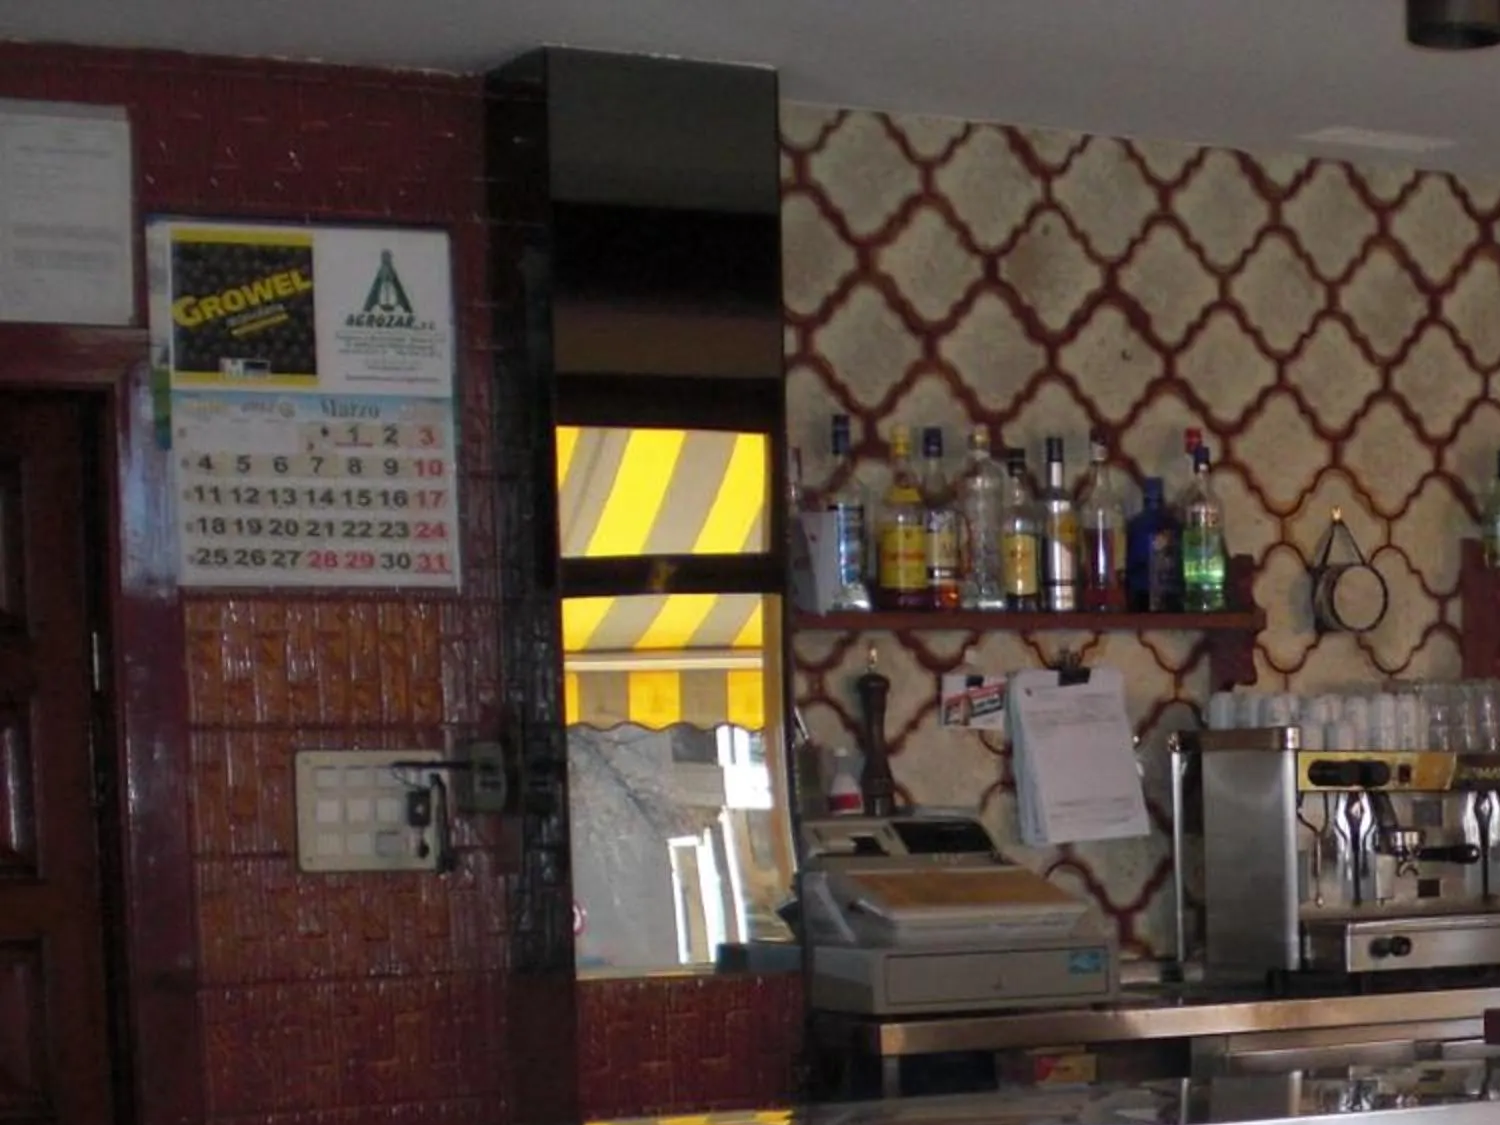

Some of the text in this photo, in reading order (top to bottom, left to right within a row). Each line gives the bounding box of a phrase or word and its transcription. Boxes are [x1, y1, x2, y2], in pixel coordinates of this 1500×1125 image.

[172, 269, 312, 327] GROWEL
[320, 398, 381, 419] Marzo
[348, 426, 434, 446] 1 2 3
[198, 455, 443, 477] 4 5 6 7 8 9 10
[194, 485, 443, 509] 11 12 13 14 15 16 17
[198, 517, 446, 539] 18 19 20 21 22 23 24
[198, 548, 446, 571] 25 26 27 28 29 30 31
